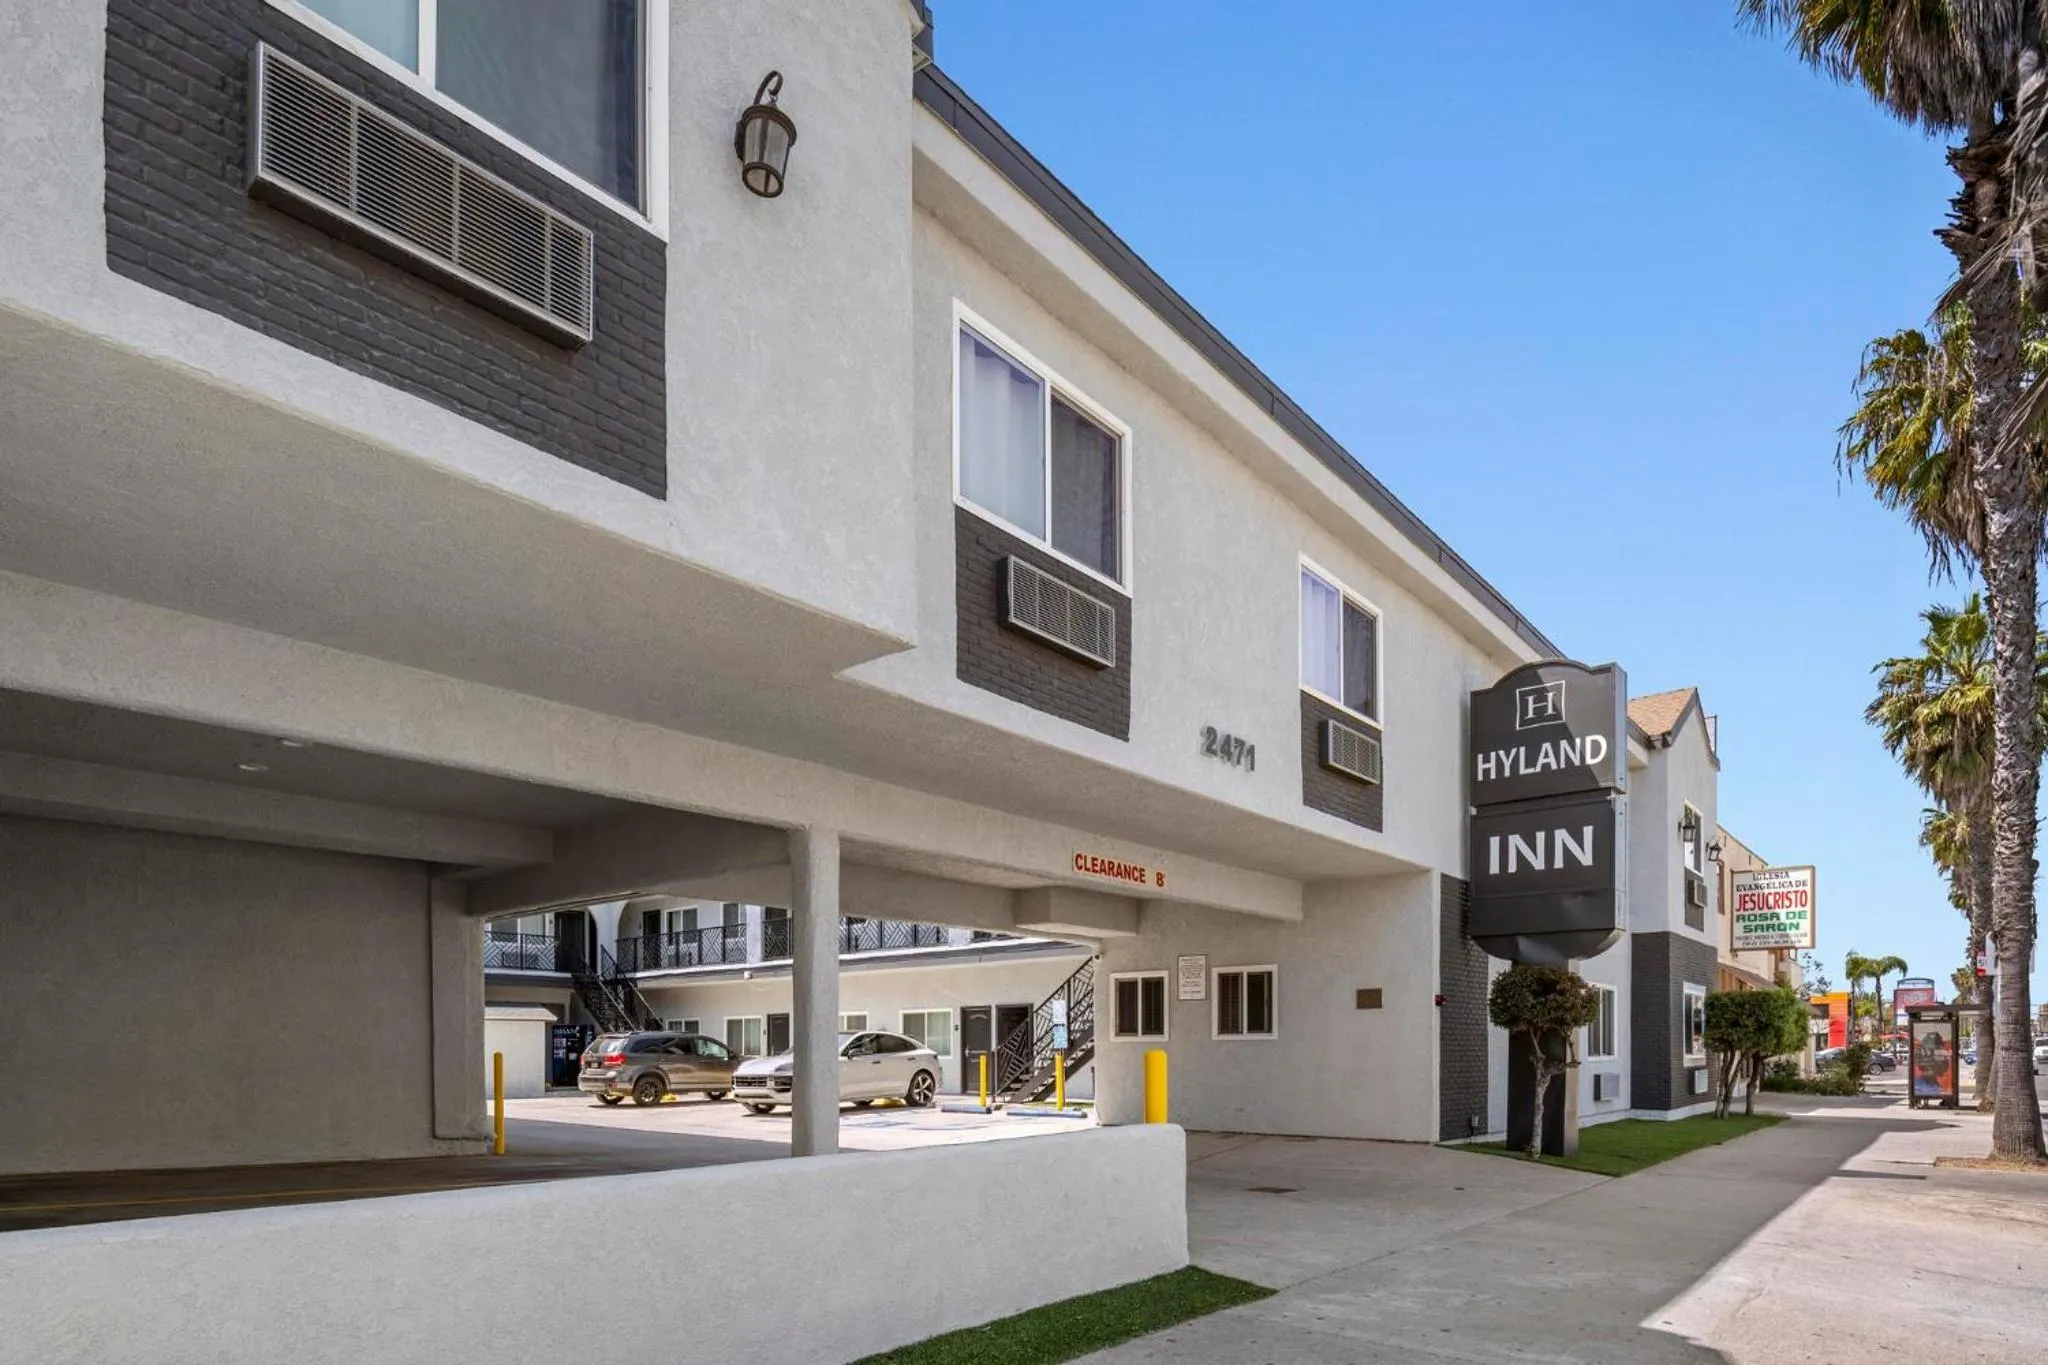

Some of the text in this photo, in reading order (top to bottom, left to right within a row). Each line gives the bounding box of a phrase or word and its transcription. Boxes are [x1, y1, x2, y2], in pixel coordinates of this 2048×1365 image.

[1203, 726, 1256, 772] 2471
[1477, 734, 1608, 782] HYLAND
[1488, 825, 1594, 875] INN
[1074, 853, 1147, 884] CLEARANCE
[1752, 872, 1790, 881] IGLESIA
[1736, 881, 1794, 892] EVANGELICA
[1735, 889, 1808, 912] JESUCRISTO
[1736, 910, 1808, 923] ROSA DE
[1743, 922, 1801, 934] SARON
